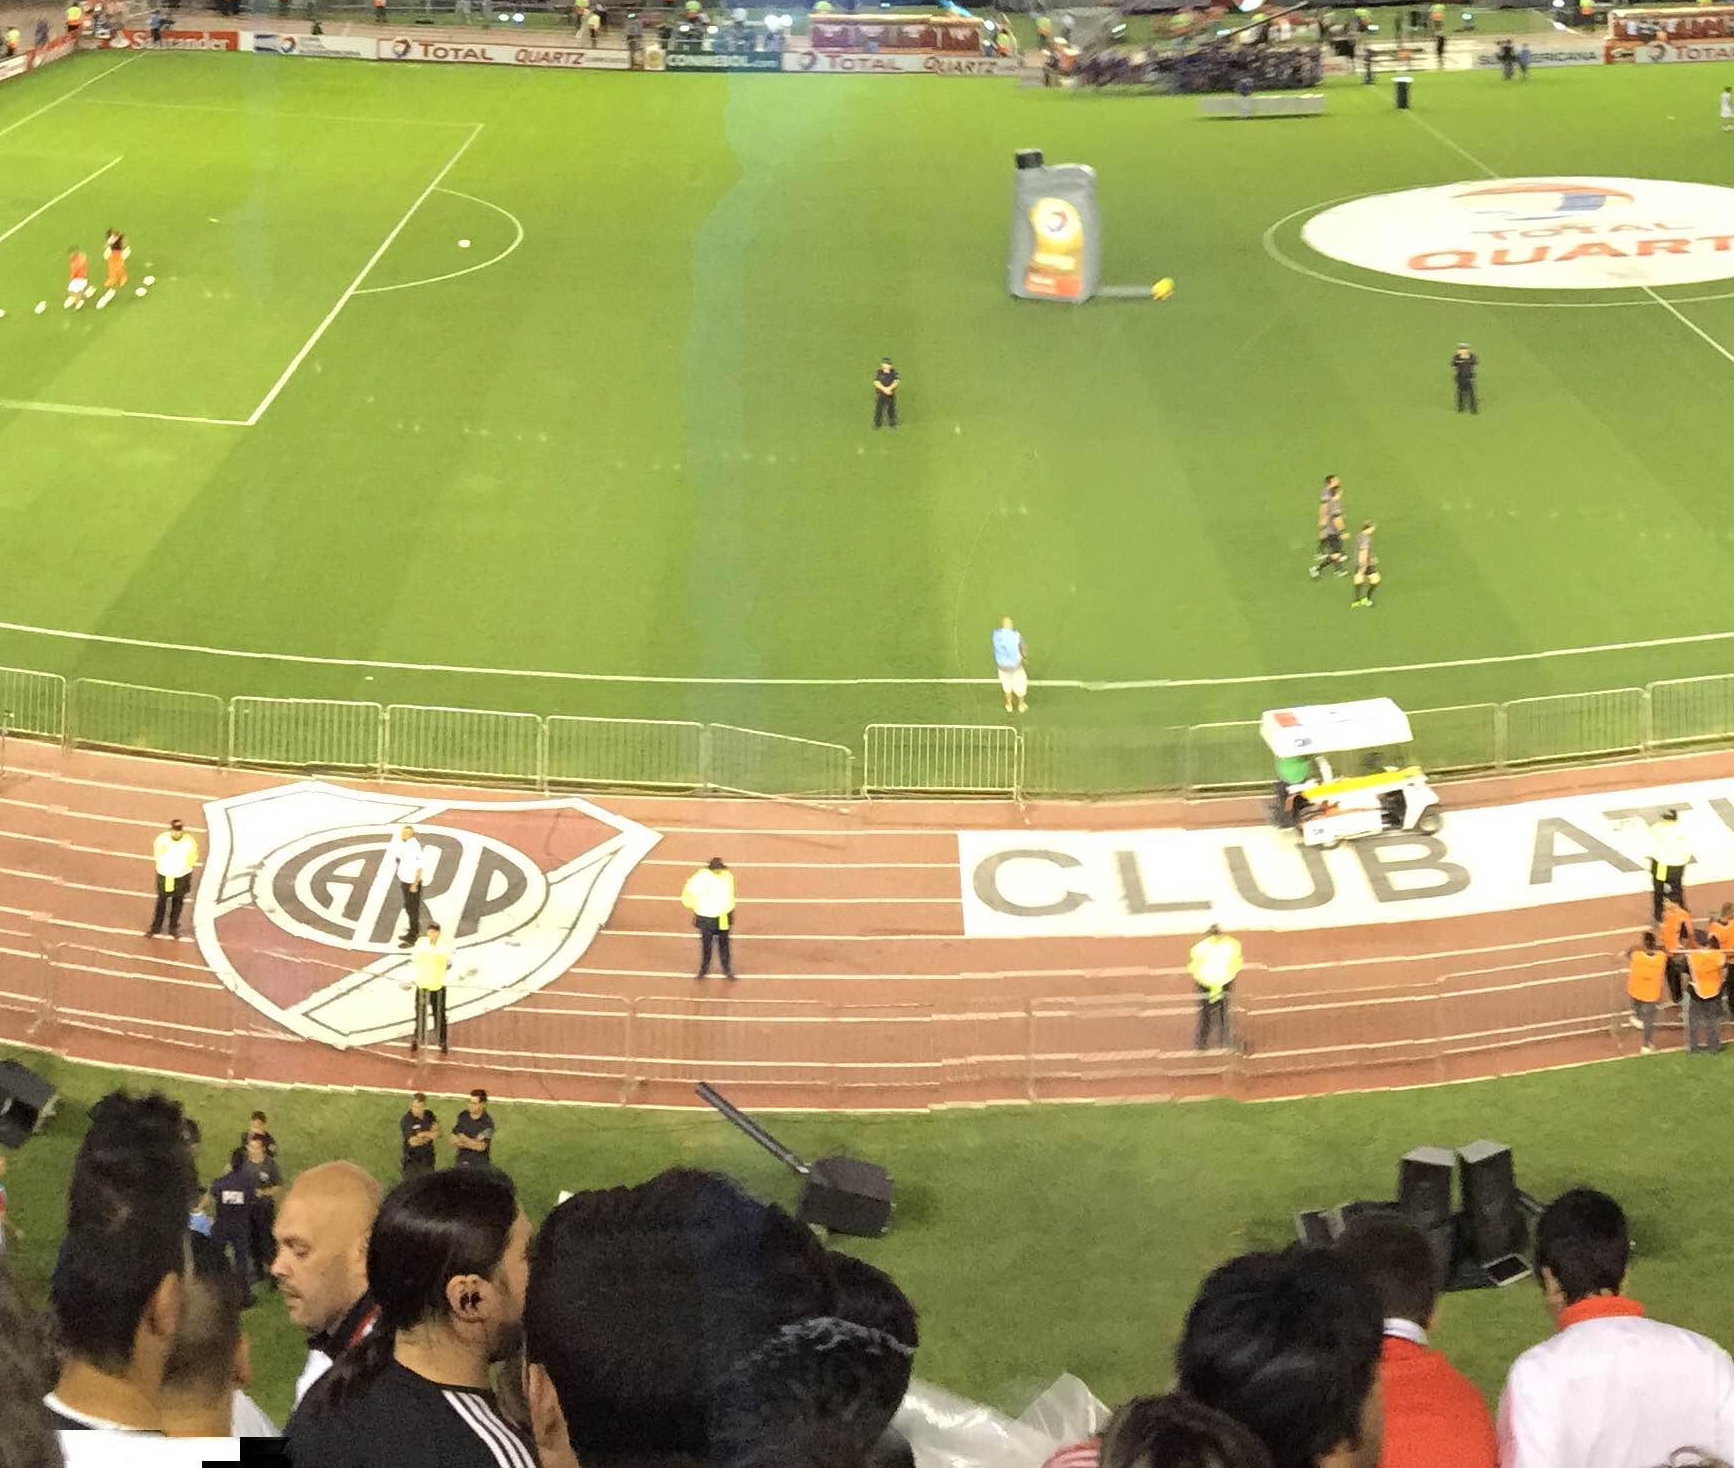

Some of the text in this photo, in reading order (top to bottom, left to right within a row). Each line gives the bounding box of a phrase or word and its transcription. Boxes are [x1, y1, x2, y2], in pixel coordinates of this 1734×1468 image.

[419, 42, 493, 62] TOTAL
[514, 47, 586, 66] QUARTZ
[829, 53, 997, 75] TOTAL QUARTZ
[1469, 219, 1696, 243] TOTAL
[972, 835, 1471, 917] CLUB
